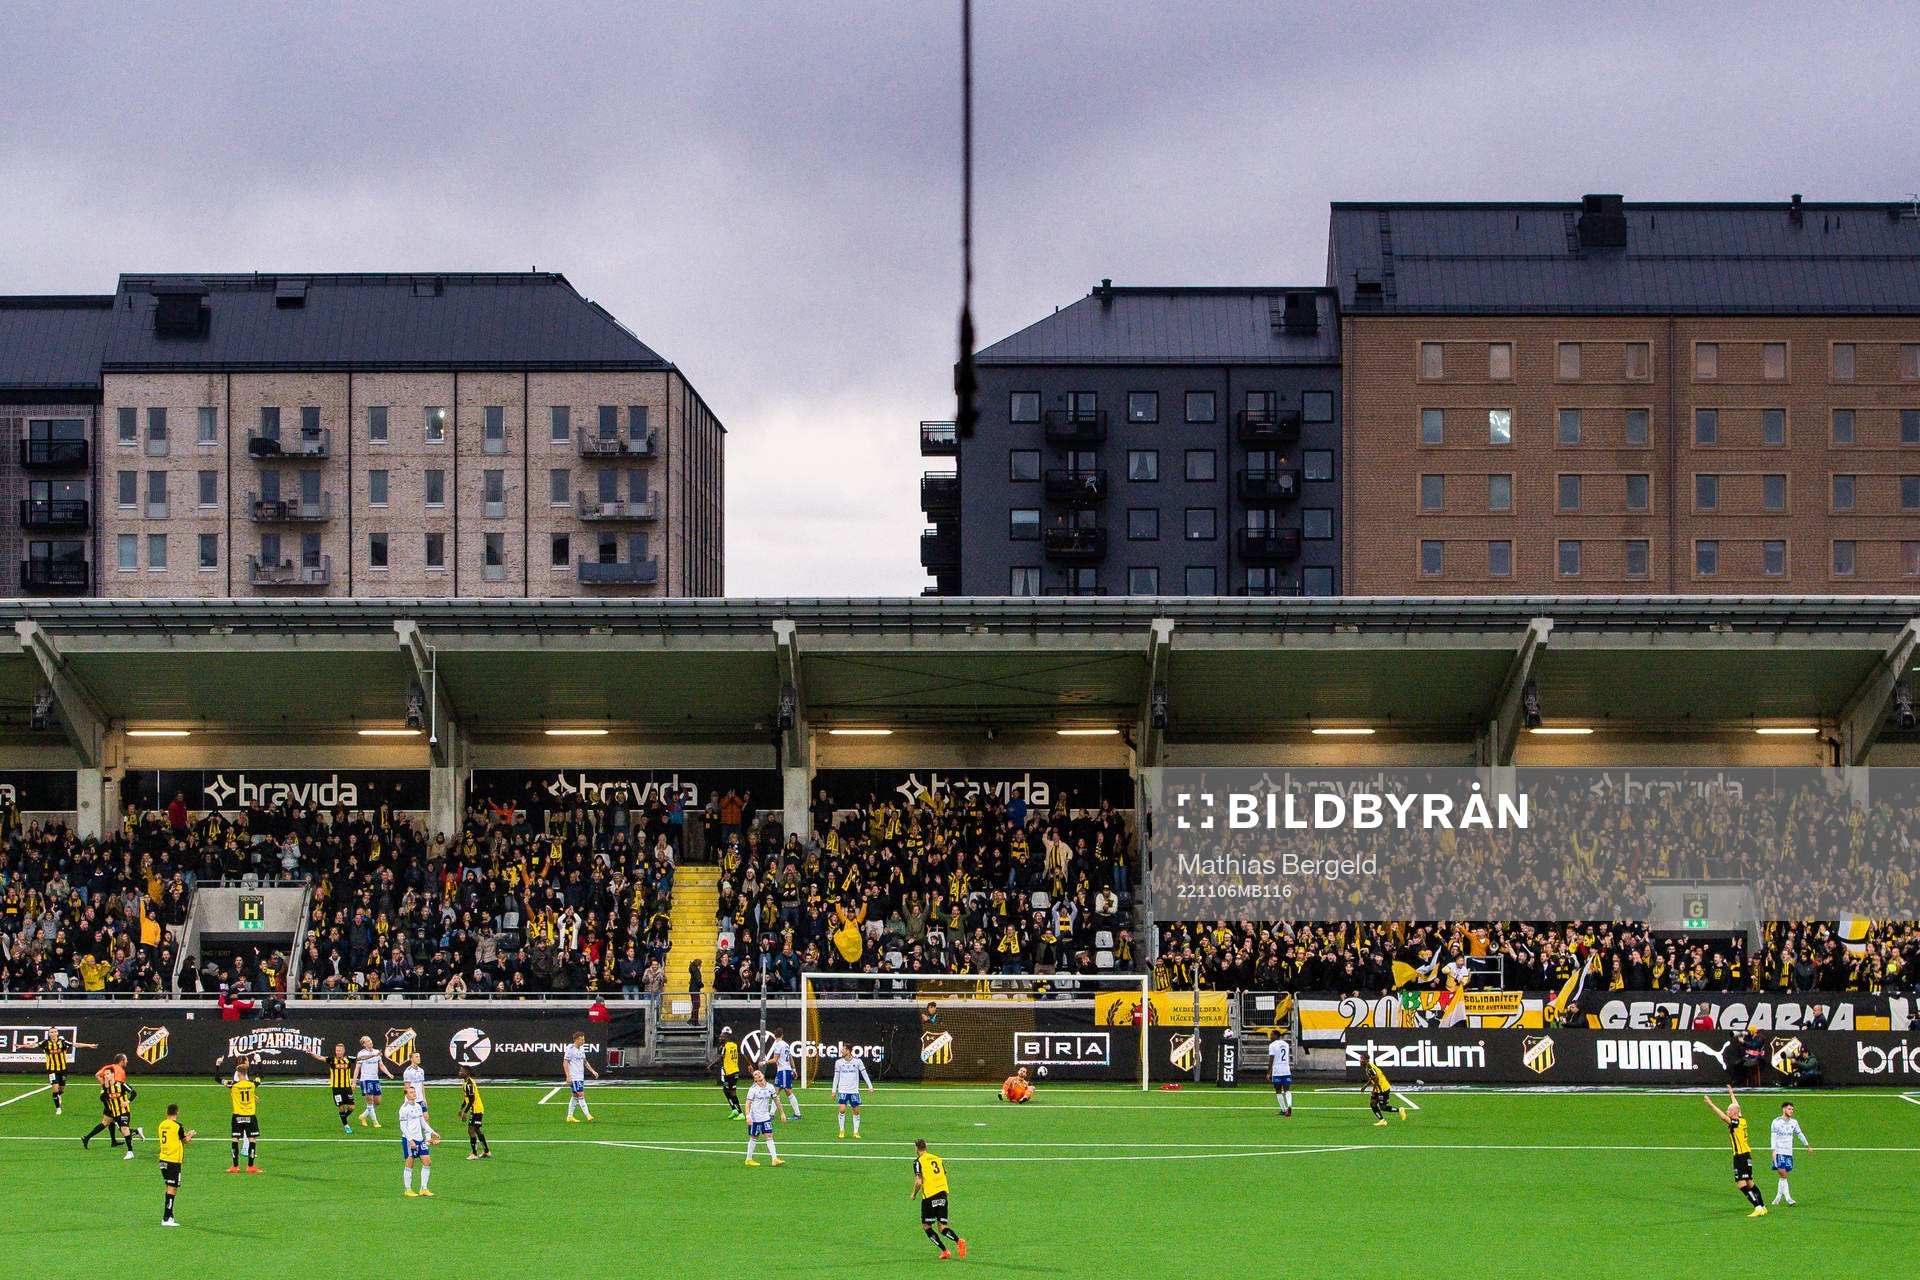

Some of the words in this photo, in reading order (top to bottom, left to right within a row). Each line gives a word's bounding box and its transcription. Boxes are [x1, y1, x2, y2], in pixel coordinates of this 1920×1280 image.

[239, 774, 358, 807] bravida
[244, 902, 258, 920] H
[1689, 900, 1704, 918] G
[1464, 994, 1519, 1003] SOLIDARITET
[228, 1033, 322, 1058] KOPPARBERG
[495, 1043, 600, 1053] KRANPUNKEN
[1346, 1039, 1486, 1068] stadium
[1223, 1044, 1235, 1082] SELECT
[1280, 1048, 1287, 1062] 2
[1596, 1039, 1694, 1071] PUMA
[239, 1090, 250, 1102] 11
[161, 1130, 168, 1145] 5
[930, 1160, 941, 1175] 3
